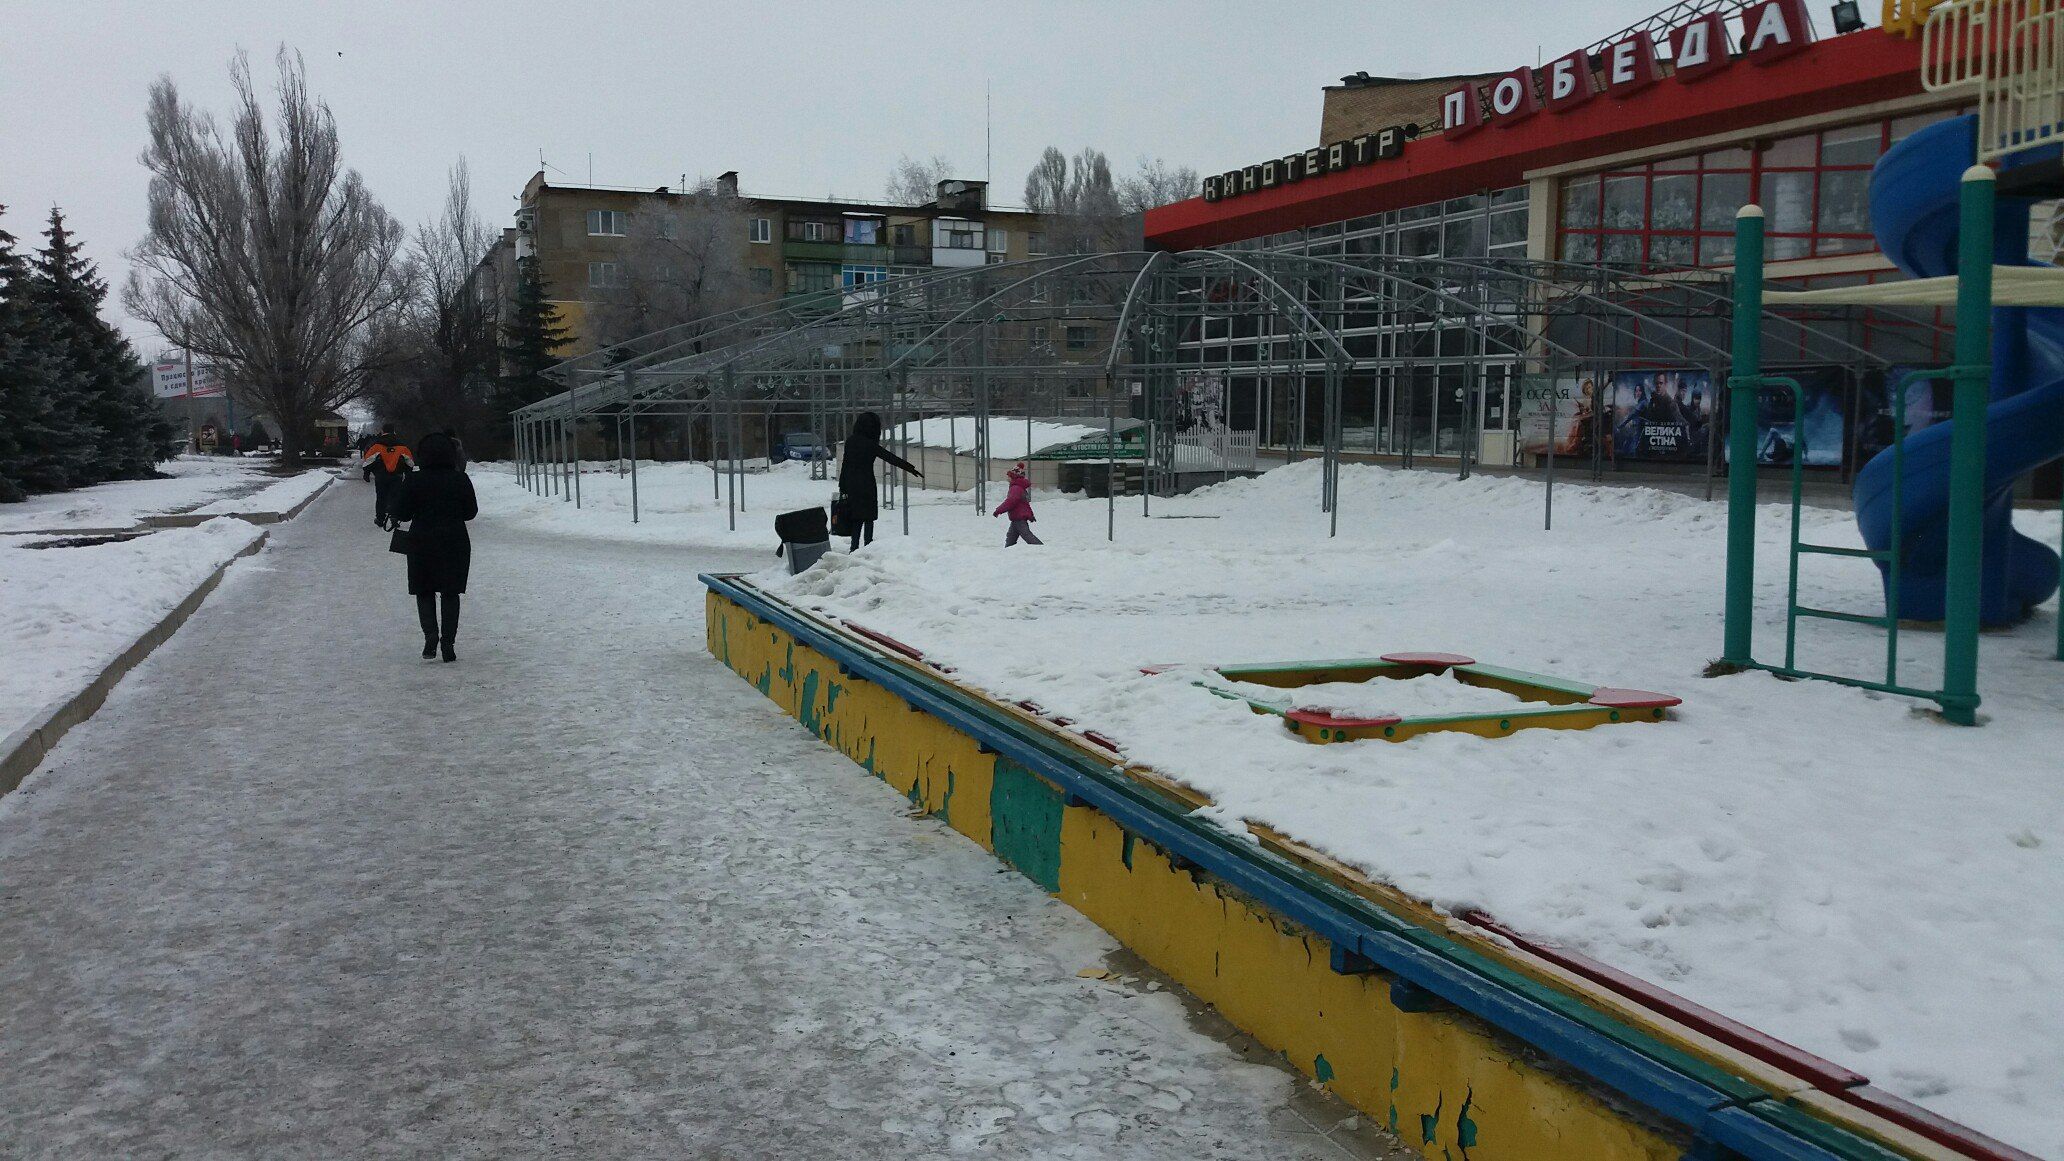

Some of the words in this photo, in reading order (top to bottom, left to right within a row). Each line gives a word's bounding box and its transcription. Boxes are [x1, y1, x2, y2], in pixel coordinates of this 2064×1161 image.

[1444, 1, 1790, 130] ПОБЕДА
[1204, 128, 1395, 199] КИНОТЕАТР
[1644, 426, 1682, 436] ВЕЛИКА
[1649, 436, 1677, 446] СТІНА
